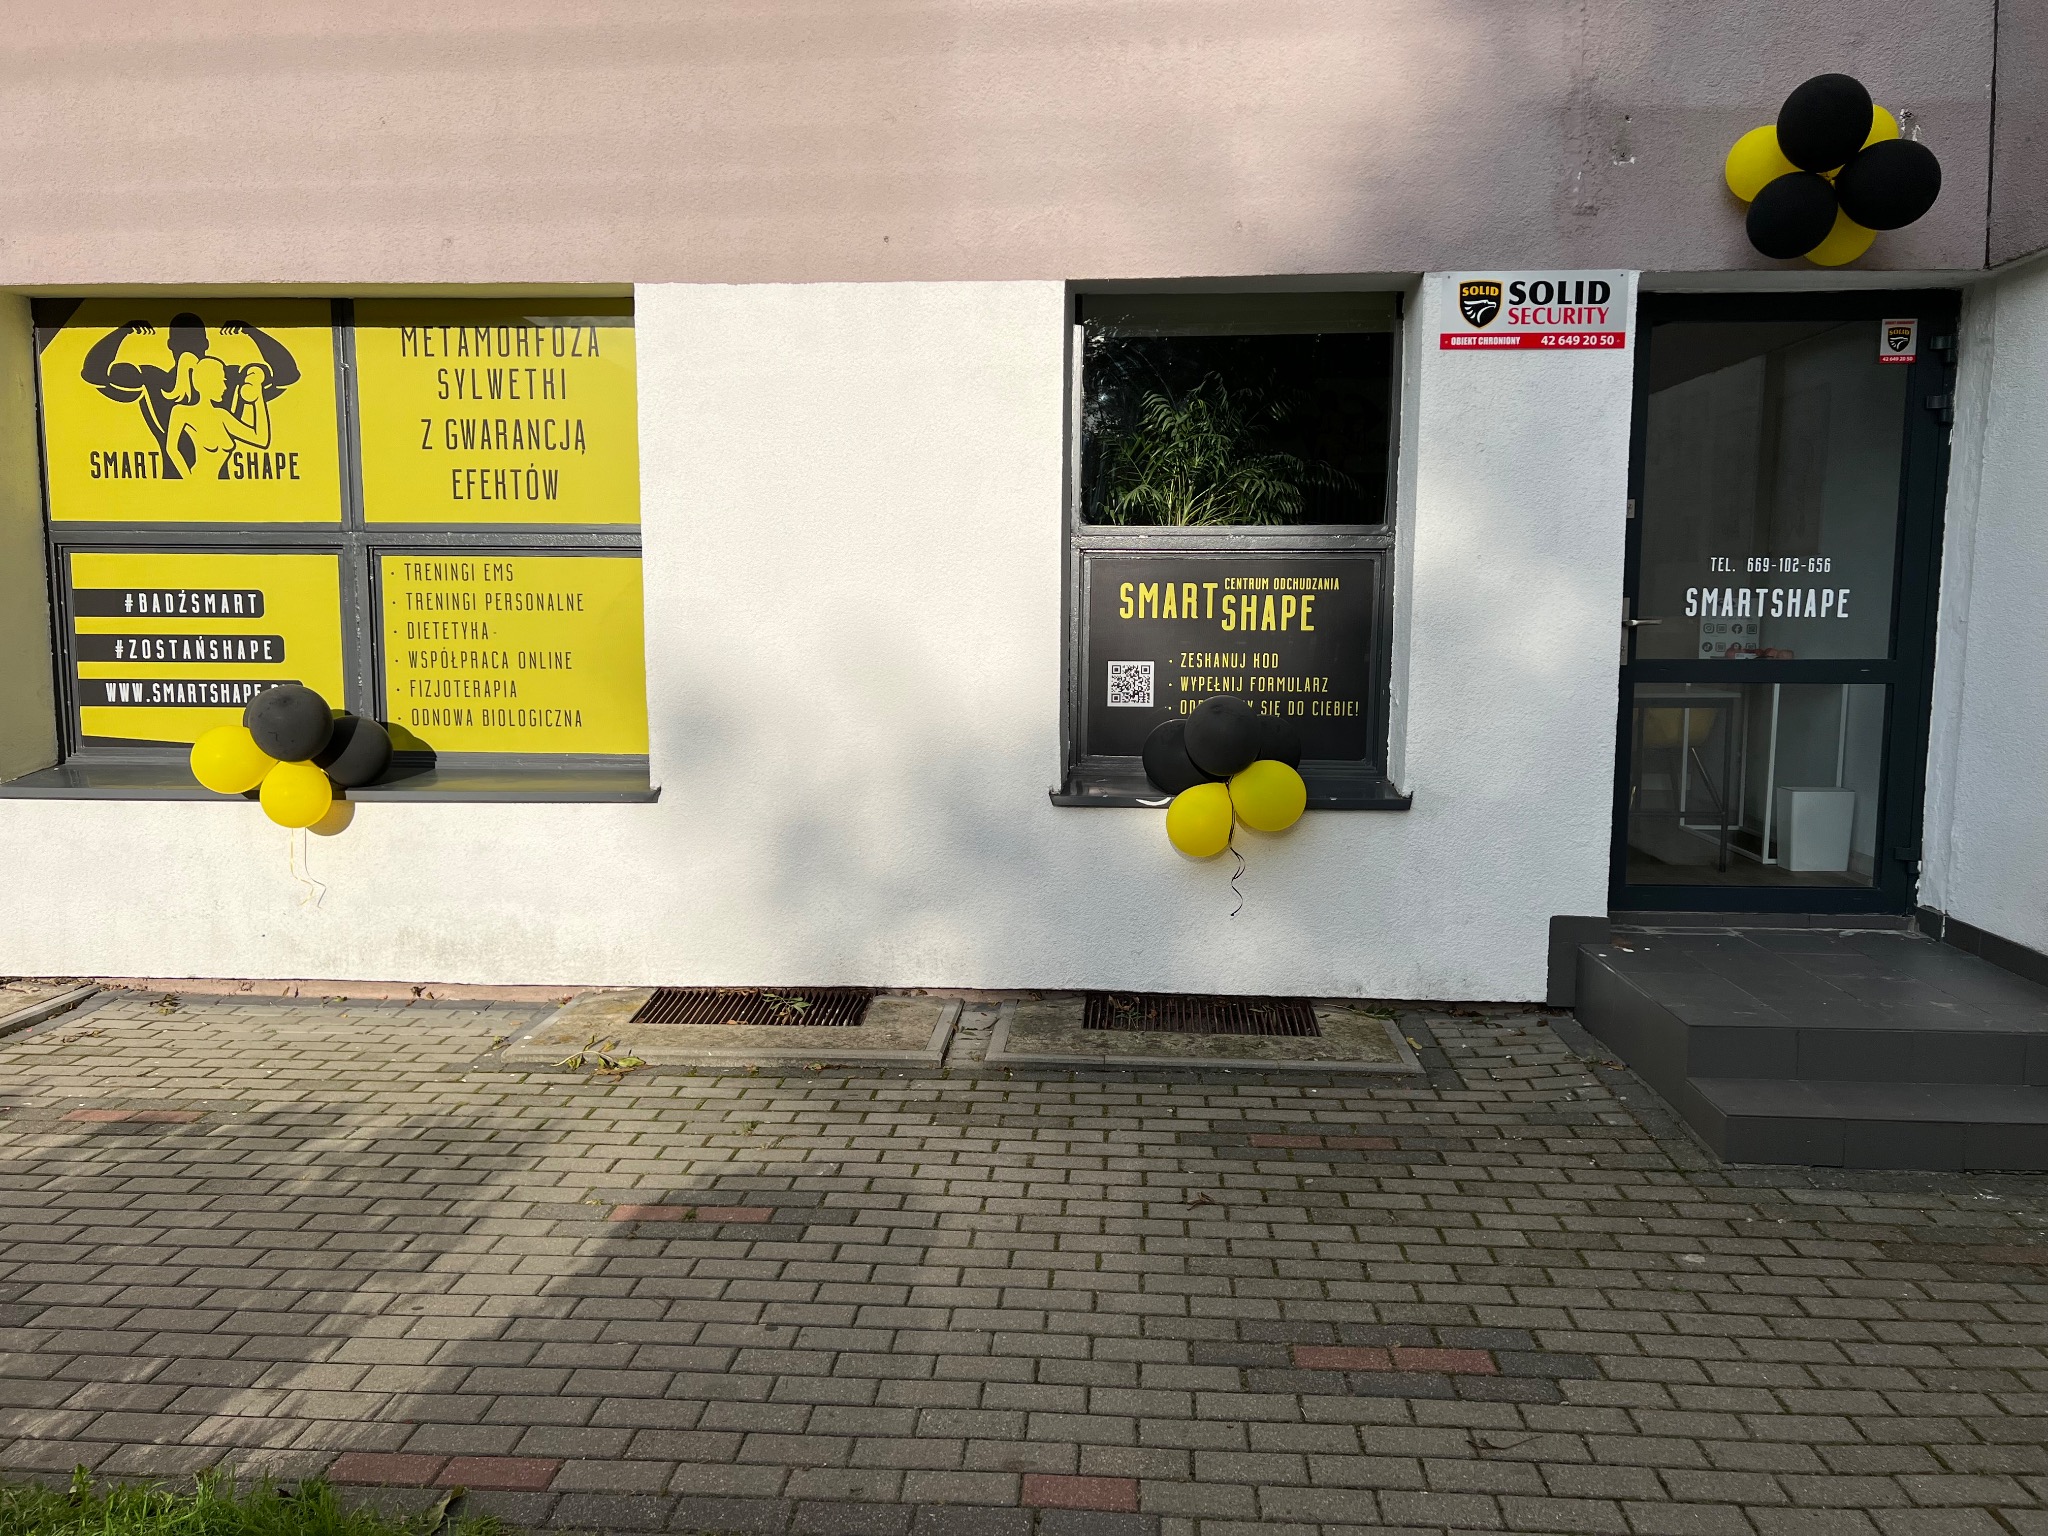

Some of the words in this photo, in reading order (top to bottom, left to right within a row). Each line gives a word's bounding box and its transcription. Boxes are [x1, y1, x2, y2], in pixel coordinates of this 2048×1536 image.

[1462, 285, 1499, 297] SOLID
[1508, 280, 1611, 306] SOLID
[1507, 306, 1611, 326] SECURITY
[400, 325, 600, 358] METAMORFOZA
[1450, 336, 1477, 346] OBIEKT
[1478, 336, 1521, 346] CHRONIONY
[1540, 335, 1556, 346] 42
[1558, 335, 1581, 346] 649
[1582, 335, 1598, 346] 20
[1599, 334, 1615, 345] 50
[437, 368, 567, 400] SYLWETKI
[420, 418, 433, 450] Z
[445, 418, 586, 455] GWARANCJĄ
[90, 451, 160, 479] SMART
[234, 452, 301, 480] SHAPE
[452, 463, 559, 500] EFEKTÓW
[404, 562, 476, 582] TRENINGI
[484, 563, 514, 582] EMS
[1710, 557, 1736, 572] TEL.
[1746, 557, 1832, 573] 669-102-656
[1224, 577, 1269, 590] CENTRUM
[1273, 577, 1341, 590] ODCHUDZANIA
[406, 592, 477, 611] TRENINGI
[485, 592, 585, 612] PERSONALNE
[1119, 582, 1219, 619] SMART
[1221, 594, 1316, 631] SHAPE
[1685, 587, 1851, 618] SMARTSHAPE
[407, 621, 490, 640] DIETETYKA
[114, 635, 273, 660] #ZOSTAŃSHAPE
[408, 646, 509, 669] WSPÓŁPRACA
[518, 651, 573, 670] ONLINE
[1180, 652, 1247, 669] ZESKANUJ
[1253, 652, 1280, 669] KOD
[410, 679, 517, 698] FIZJOTERAPIA
[1180, 676, 1243, 693] WYPEŁNIJ
[1250, 676, 1329, 693] FORMULARZ
[411, 708, 474, 727] ODNOWA
[482, 708, 583, 728] BIOLOGICZNA
[1260, 700, 1281, 718] SIĘ
[1288, 700, 1304, 716] DO
[1312, 700, 1360, 717] CIEBIE!
